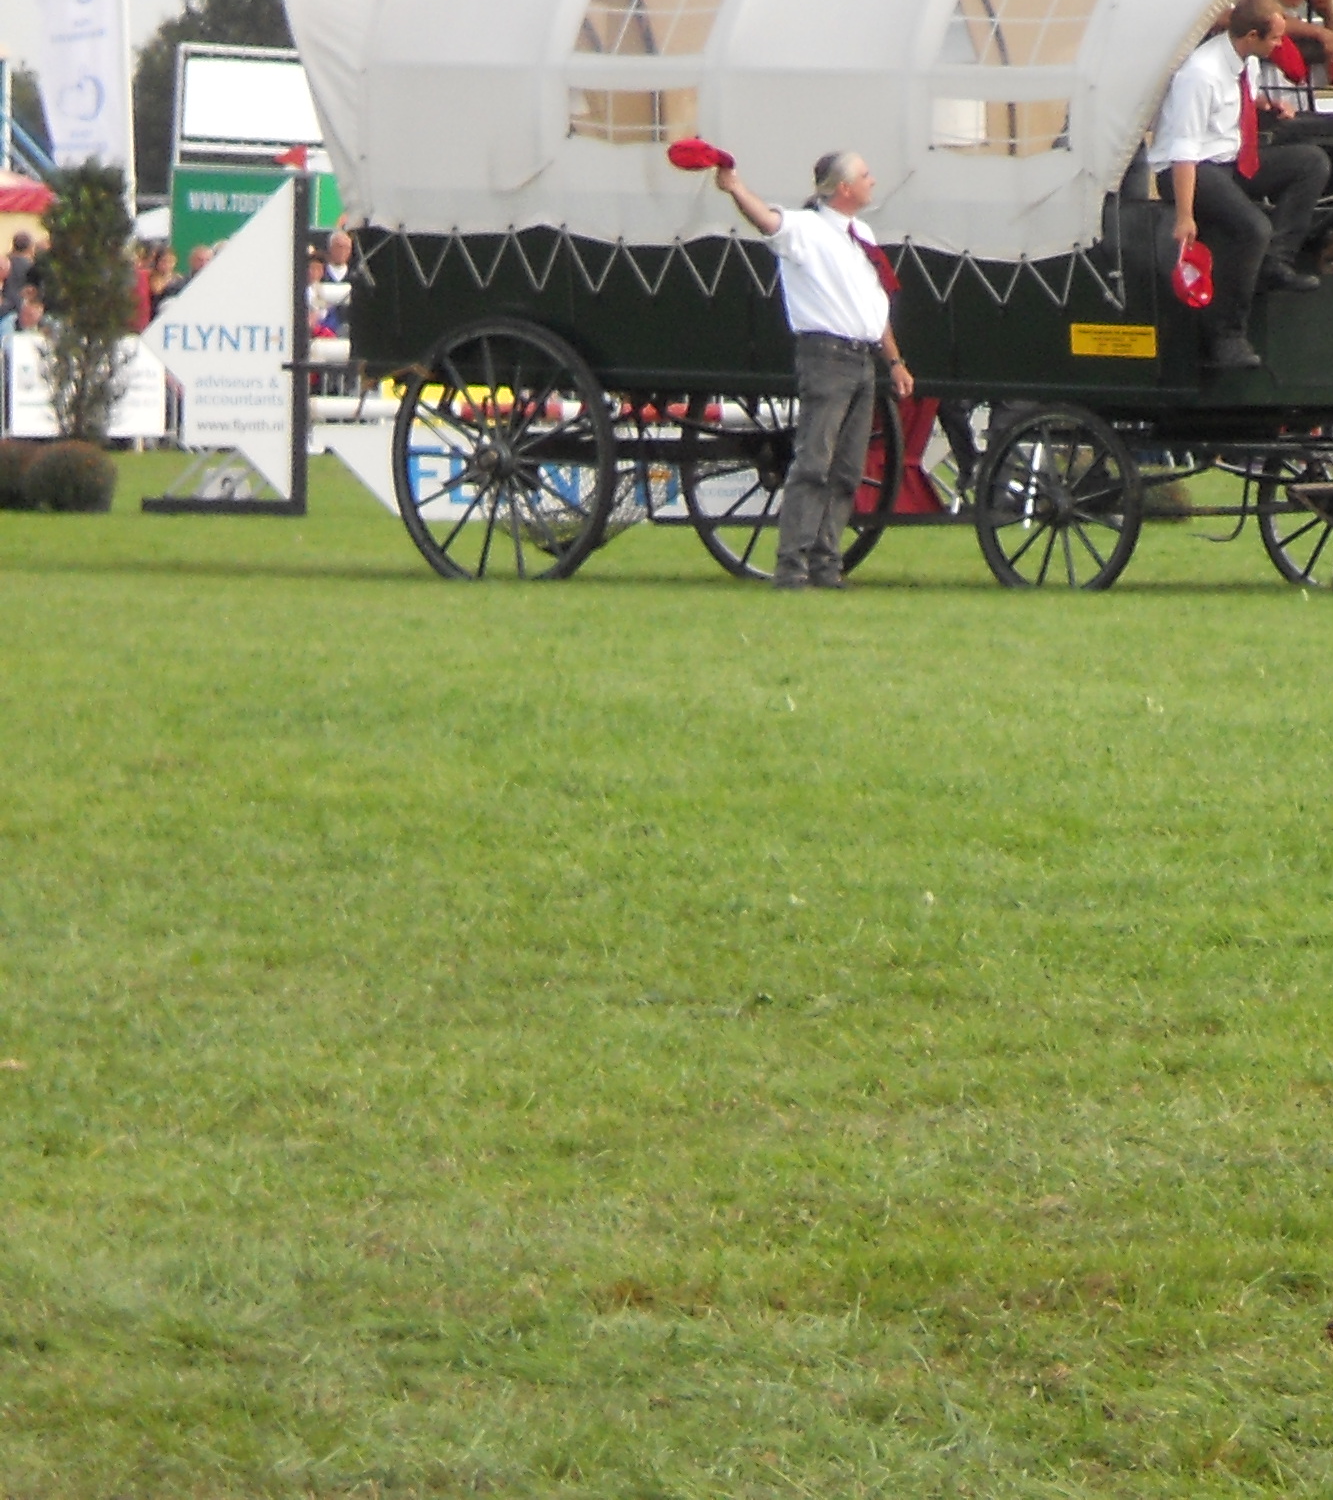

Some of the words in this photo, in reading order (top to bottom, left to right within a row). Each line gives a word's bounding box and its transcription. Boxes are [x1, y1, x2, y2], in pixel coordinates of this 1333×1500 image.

[163, 324, 284, 352] FLYNTH
[195, 375, 263, 389] adviseurs
[269, 376, 280, 389] &
[195, 392, 284, 406] accountants
